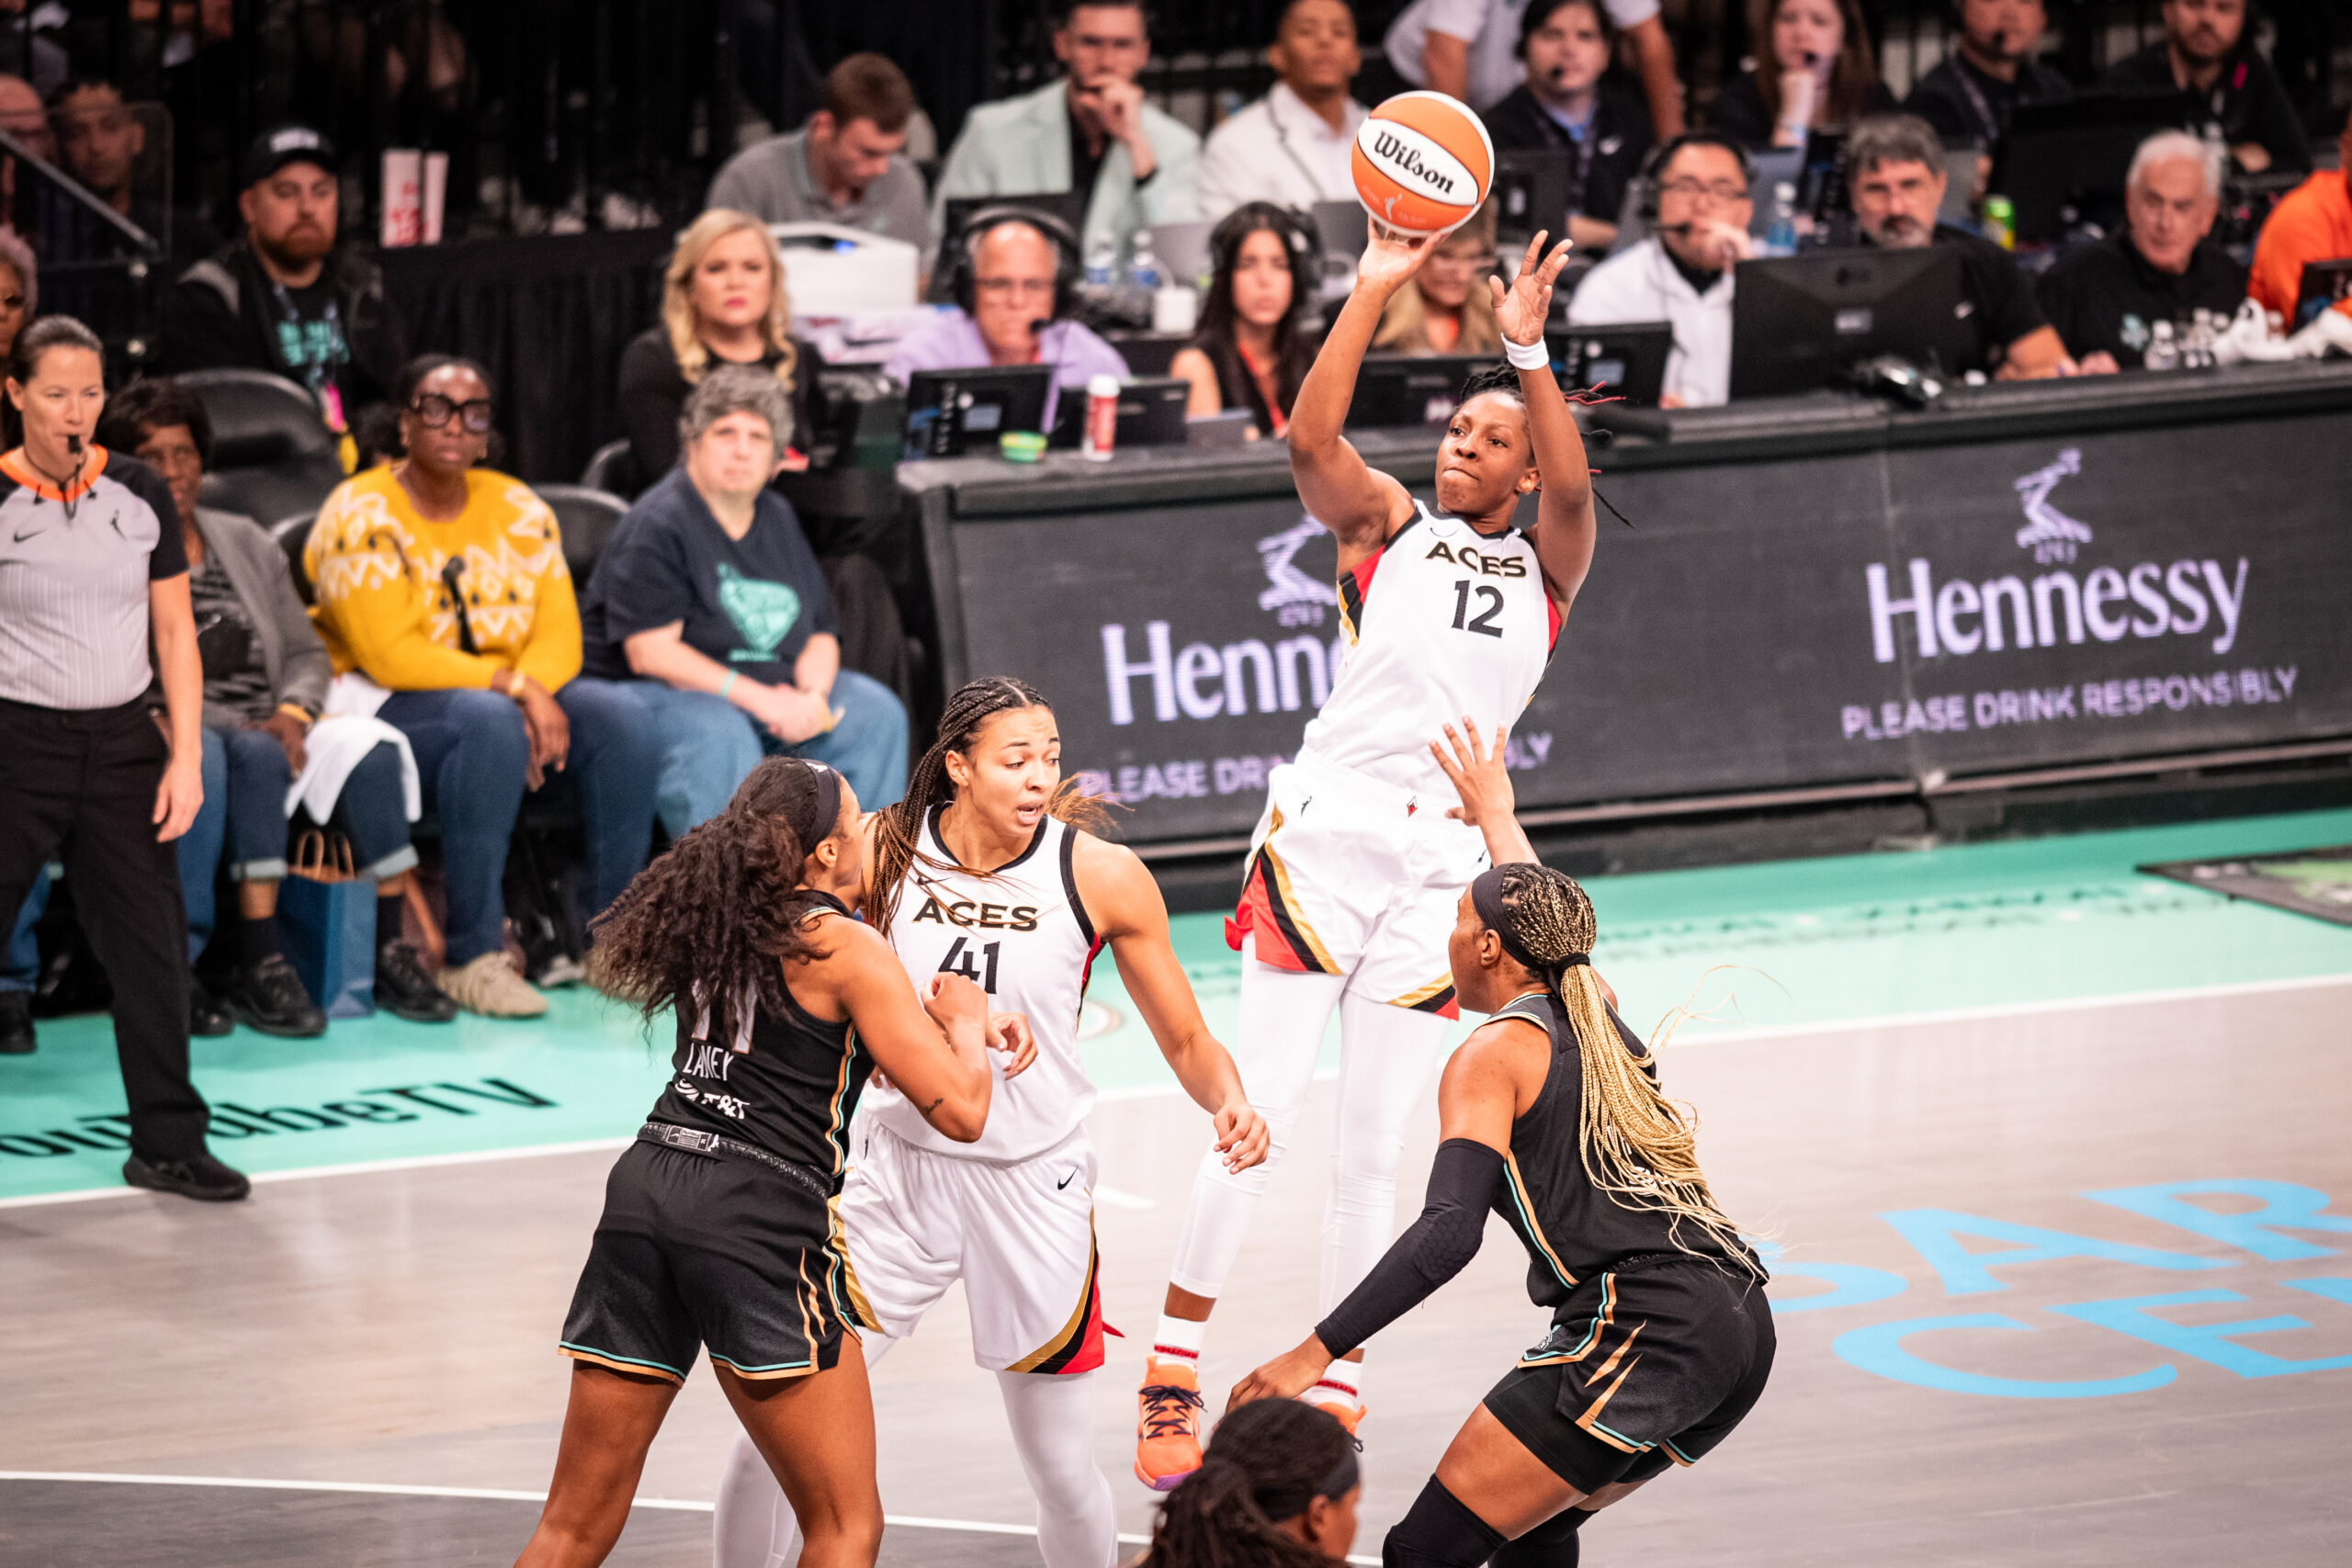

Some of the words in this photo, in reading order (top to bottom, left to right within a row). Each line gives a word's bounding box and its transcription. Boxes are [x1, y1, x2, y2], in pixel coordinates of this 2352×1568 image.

[1374, 130, 1454, 194] Wilson
[1424, 540, 1527, 580] ACES
[1451, 580, 1505, 639] 12
[1865, 557, 2250, 663] Hennessy
[1101, 620, 1343, 726] Henn
[1840, 694, 1970, 740] PLEASE
[1973, 685, 2077, 729] DRINK
[2081, 663, 2298, 716] RESPONSIBLY
[1078, 760, 1209, 804] PLEASE
[910, 897, 1039, 932] ACES
[937, 936, 1001, 995] 41
[683, 1043, 735, 1082] LANEY
[701, 1092, 751, 1120] T&T
[1831, 1275, 2352, 1399] CE
